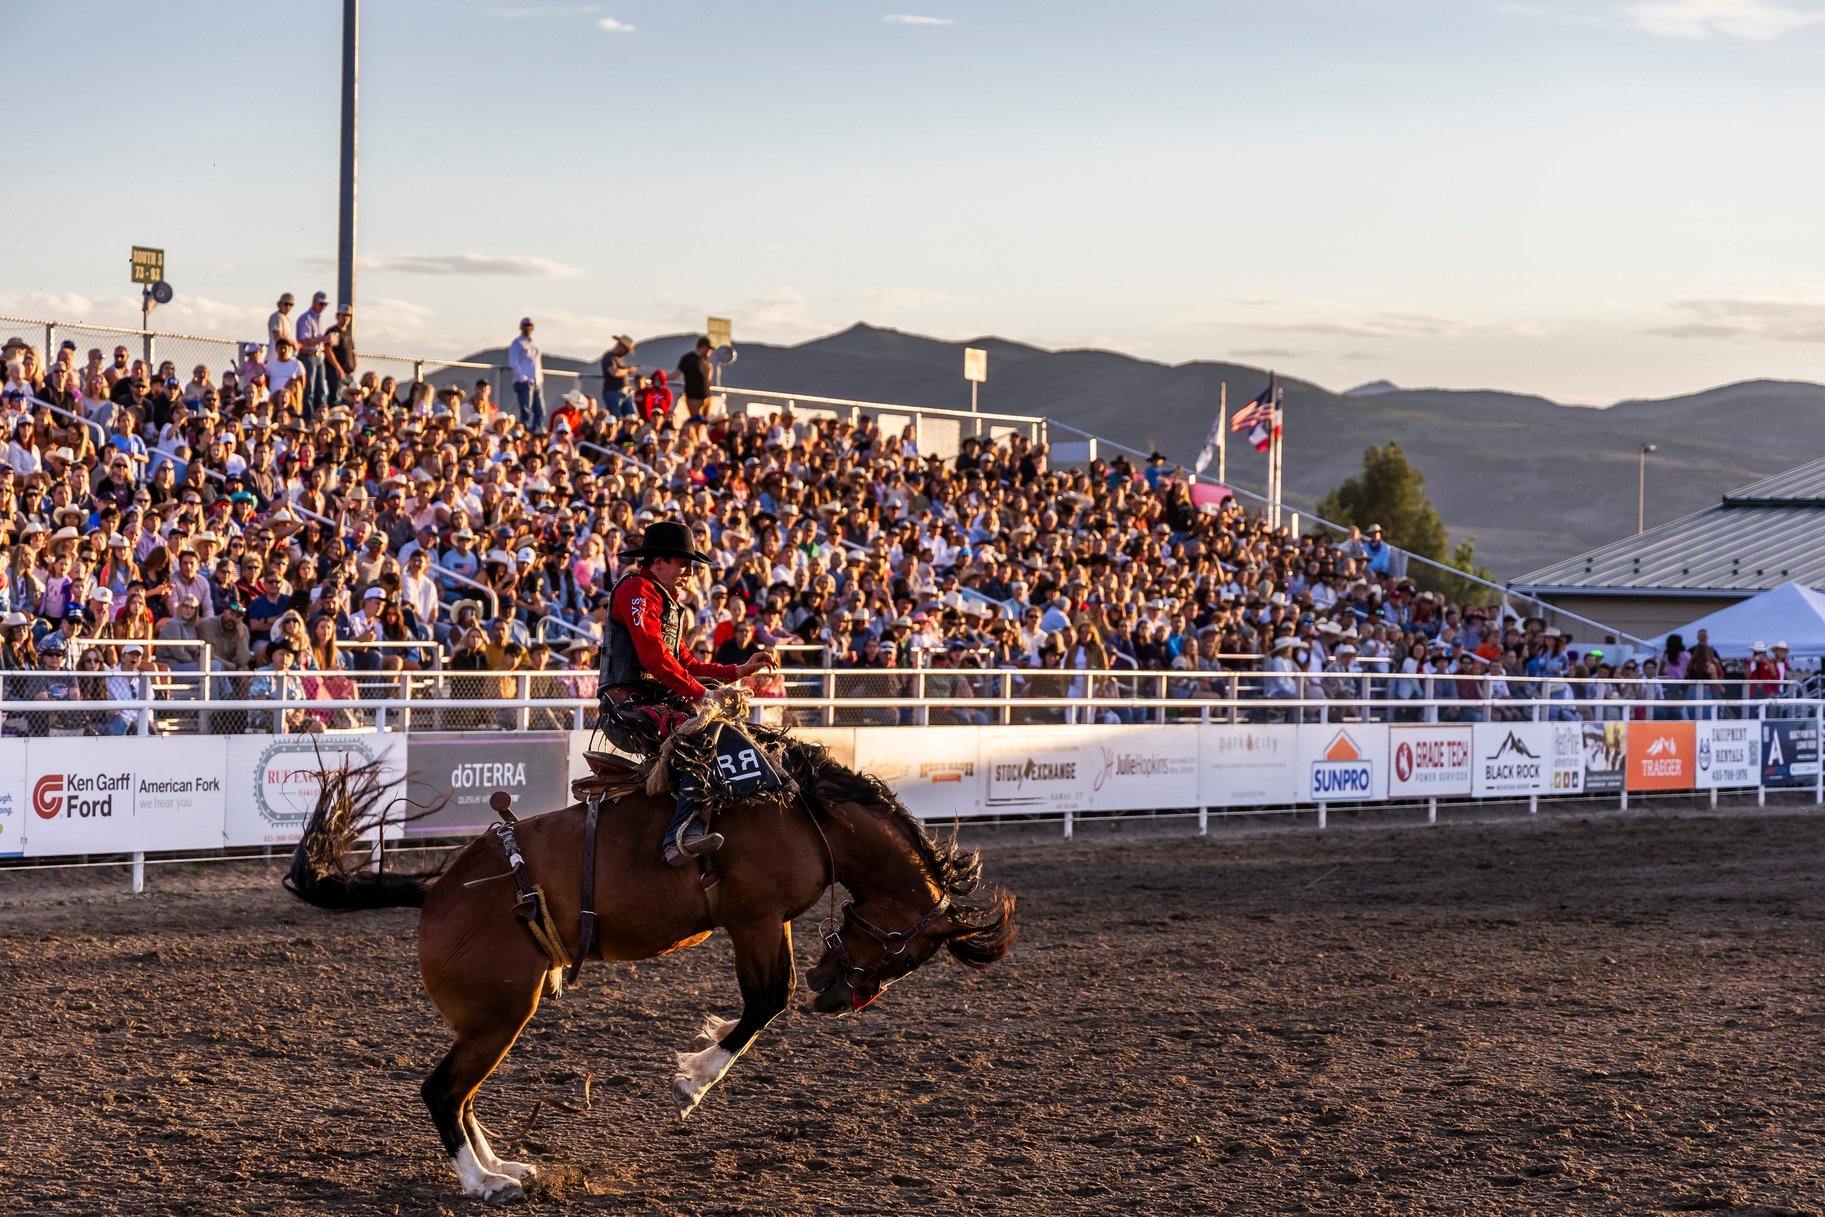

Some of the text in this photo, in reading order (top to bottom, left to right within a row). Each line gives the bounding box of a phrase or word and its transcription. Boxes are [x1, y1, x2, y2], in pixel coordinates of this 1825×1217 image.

[632, 598, 641, 626] CVS
[1712, 727, 1747, 742] EQUIPMENT
[1416, 741, 1468, 768] GRADE TECH
[1715, 749, 1744, 763] RENTALS
[451, 762, 527, 788] dōTERRA
[996, 763, 1023, 782] STOCK
[1031, 762, 1076, 781] EXCHANGE
[1486, 764, 1541, 780] BLACK ROCK
[1641, 758, 1682, 777] TRAEGER
[67, 773, 130, 791] Ken Garff
[139, 777, 220, 793] American Fork
[1314, 768, 1370, 793] SUNPRO
[67, 794, 112, 818] Ford
[139, 797, 192, 808] we hear you
